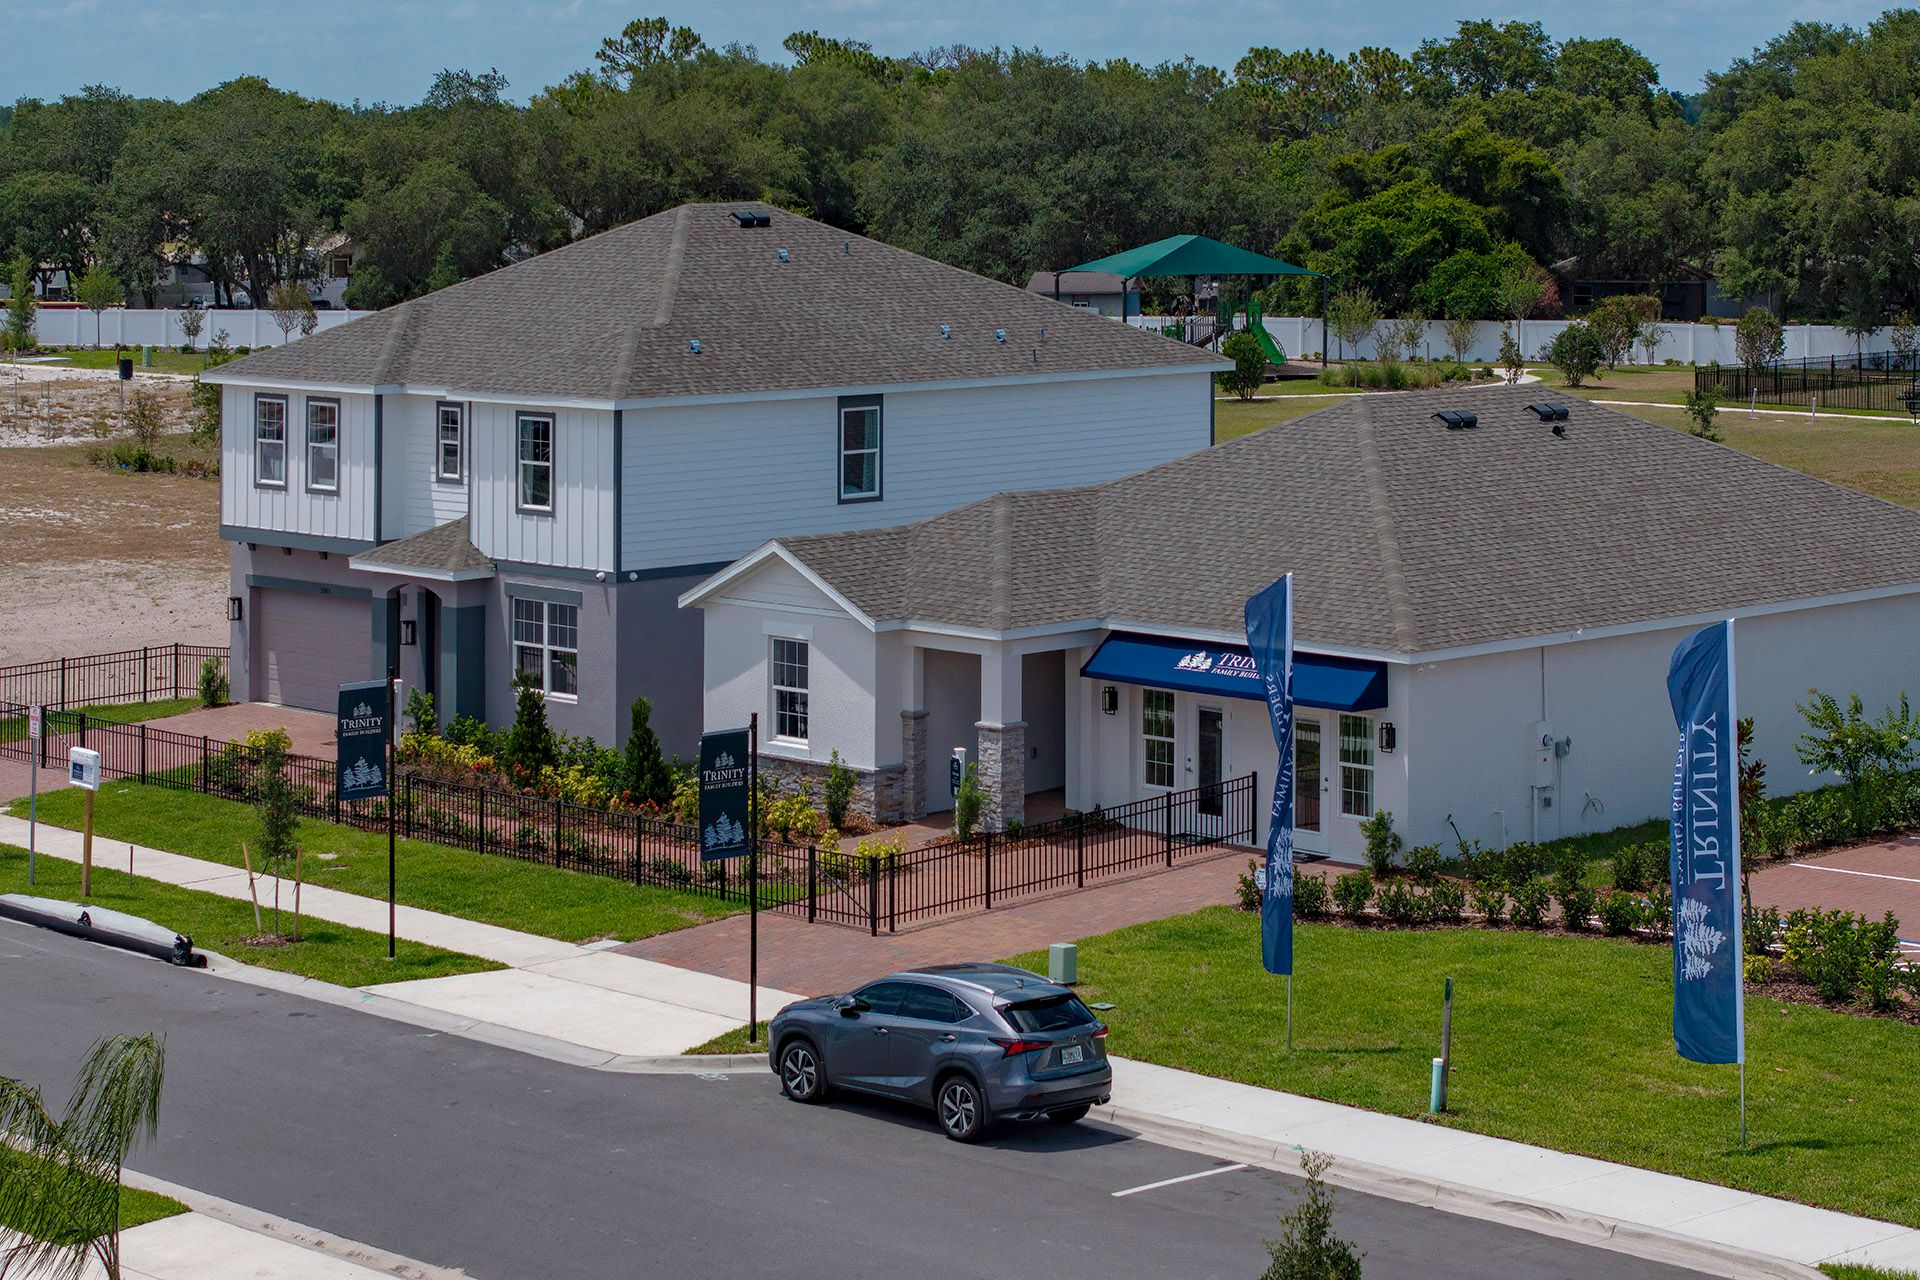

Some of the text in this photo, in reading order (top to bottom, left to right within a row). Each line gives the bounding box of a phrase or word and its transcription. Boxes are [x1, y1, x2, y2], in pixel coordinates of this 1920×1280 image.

[1220, 653, 1258, 669] TRIN
[1211, 668, 1239, 677] FAMILY
[341, 717, 382, 729] TRINITY
[703, 768, 744, 781] TRINITY
